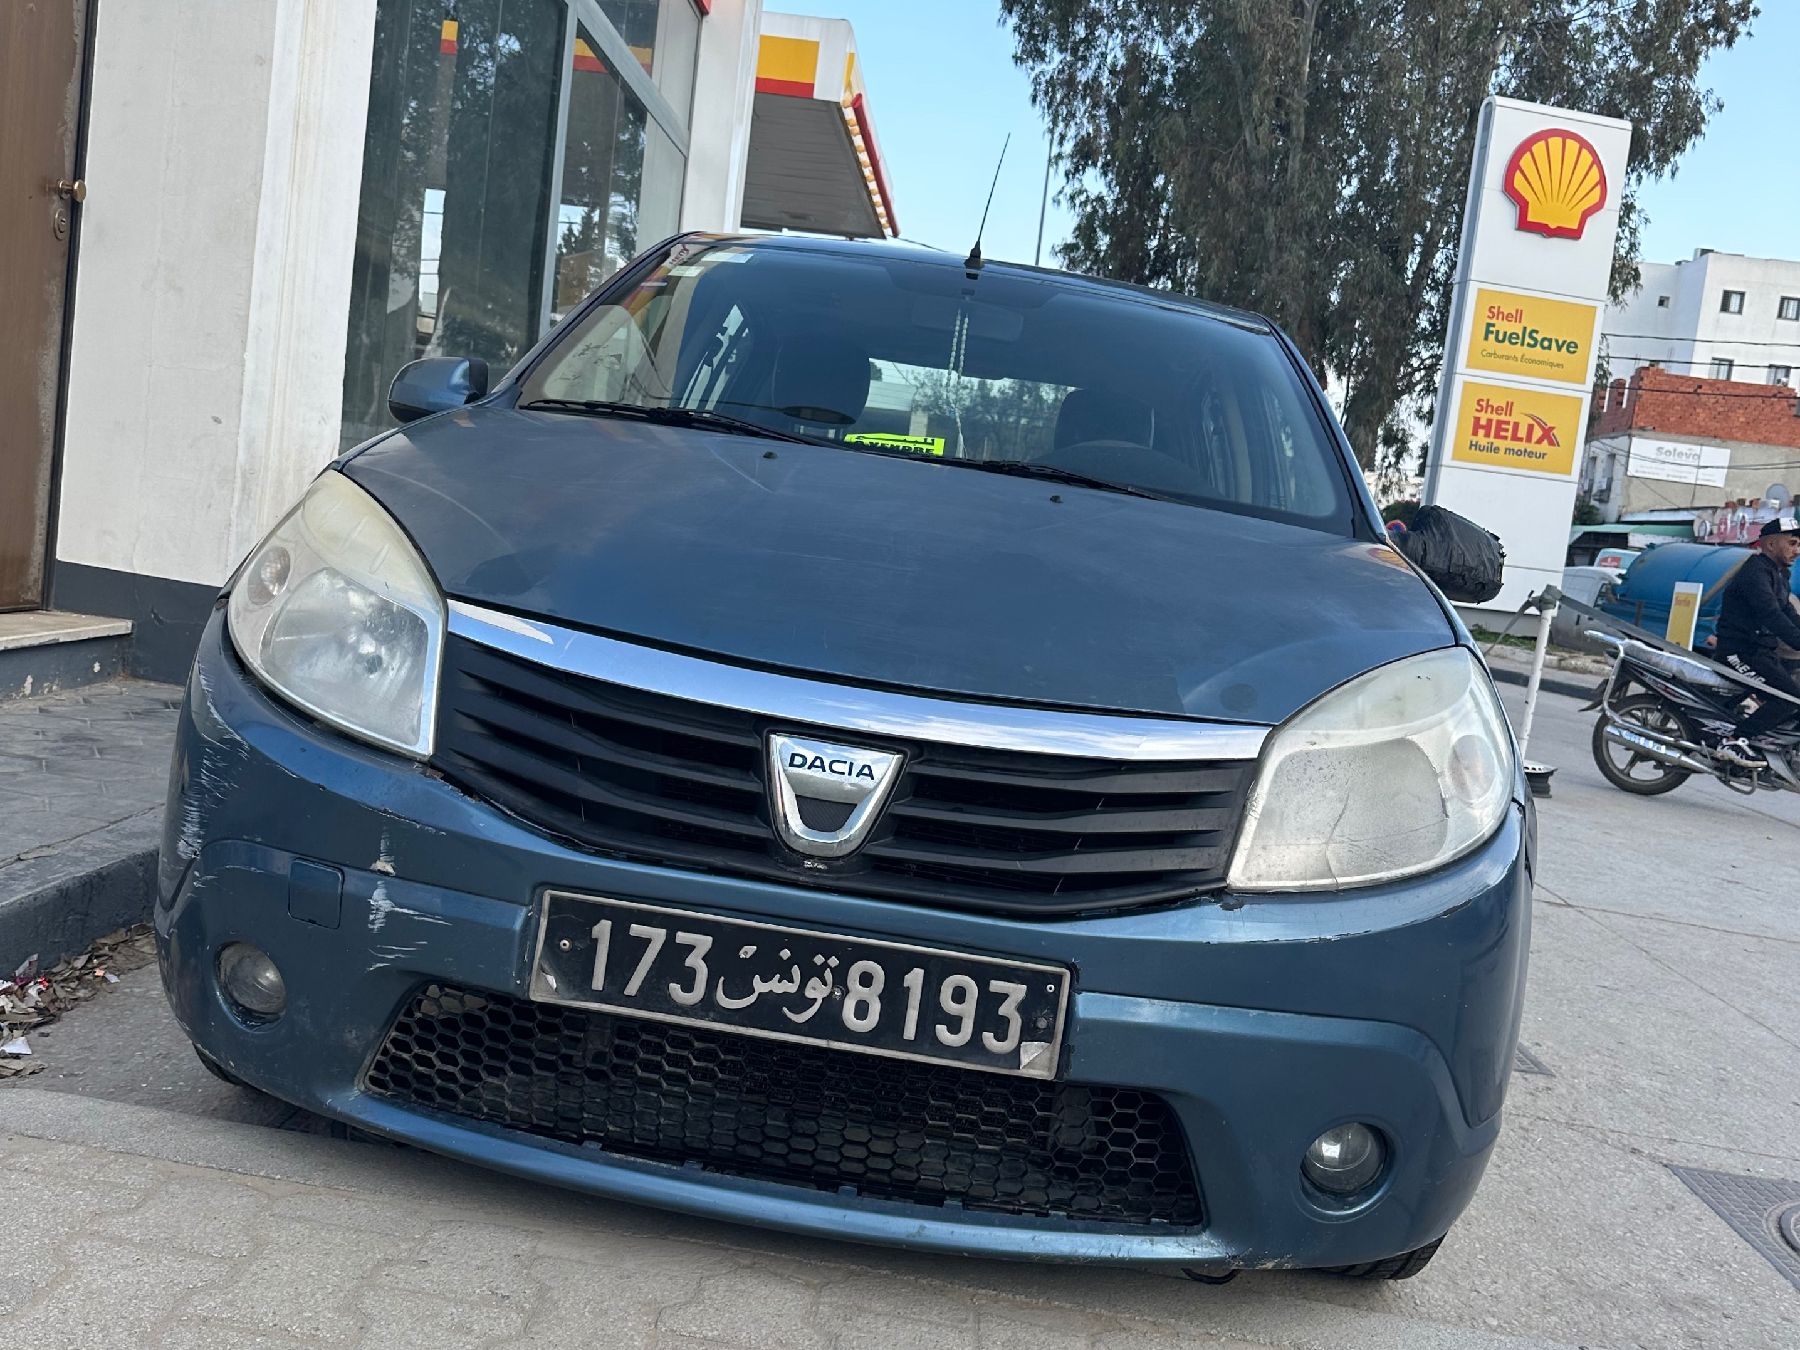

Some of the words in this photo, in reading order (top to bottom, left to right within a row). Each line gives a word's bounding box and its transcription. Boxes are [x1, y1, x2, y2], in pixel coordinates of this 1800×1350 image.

[1486, 305, 1524, 323] Shell
[1483, 322, 1579, 354] FuelSave
[1480, 349, 1519, 362] Carburants
[1474, 398, 1514, 417] Shell
[1471, 413, 1560, 447] HELIX
[1468, 440, 1500, 455] Huile
[1504, 446, 1548, 460] moteur
[788, 752, 875, 780] DACIA
[590, 919, 713, 1006] 173
[715, 945, 840, 1023] تونس
[841, 960, 1027, 1054] 8193
